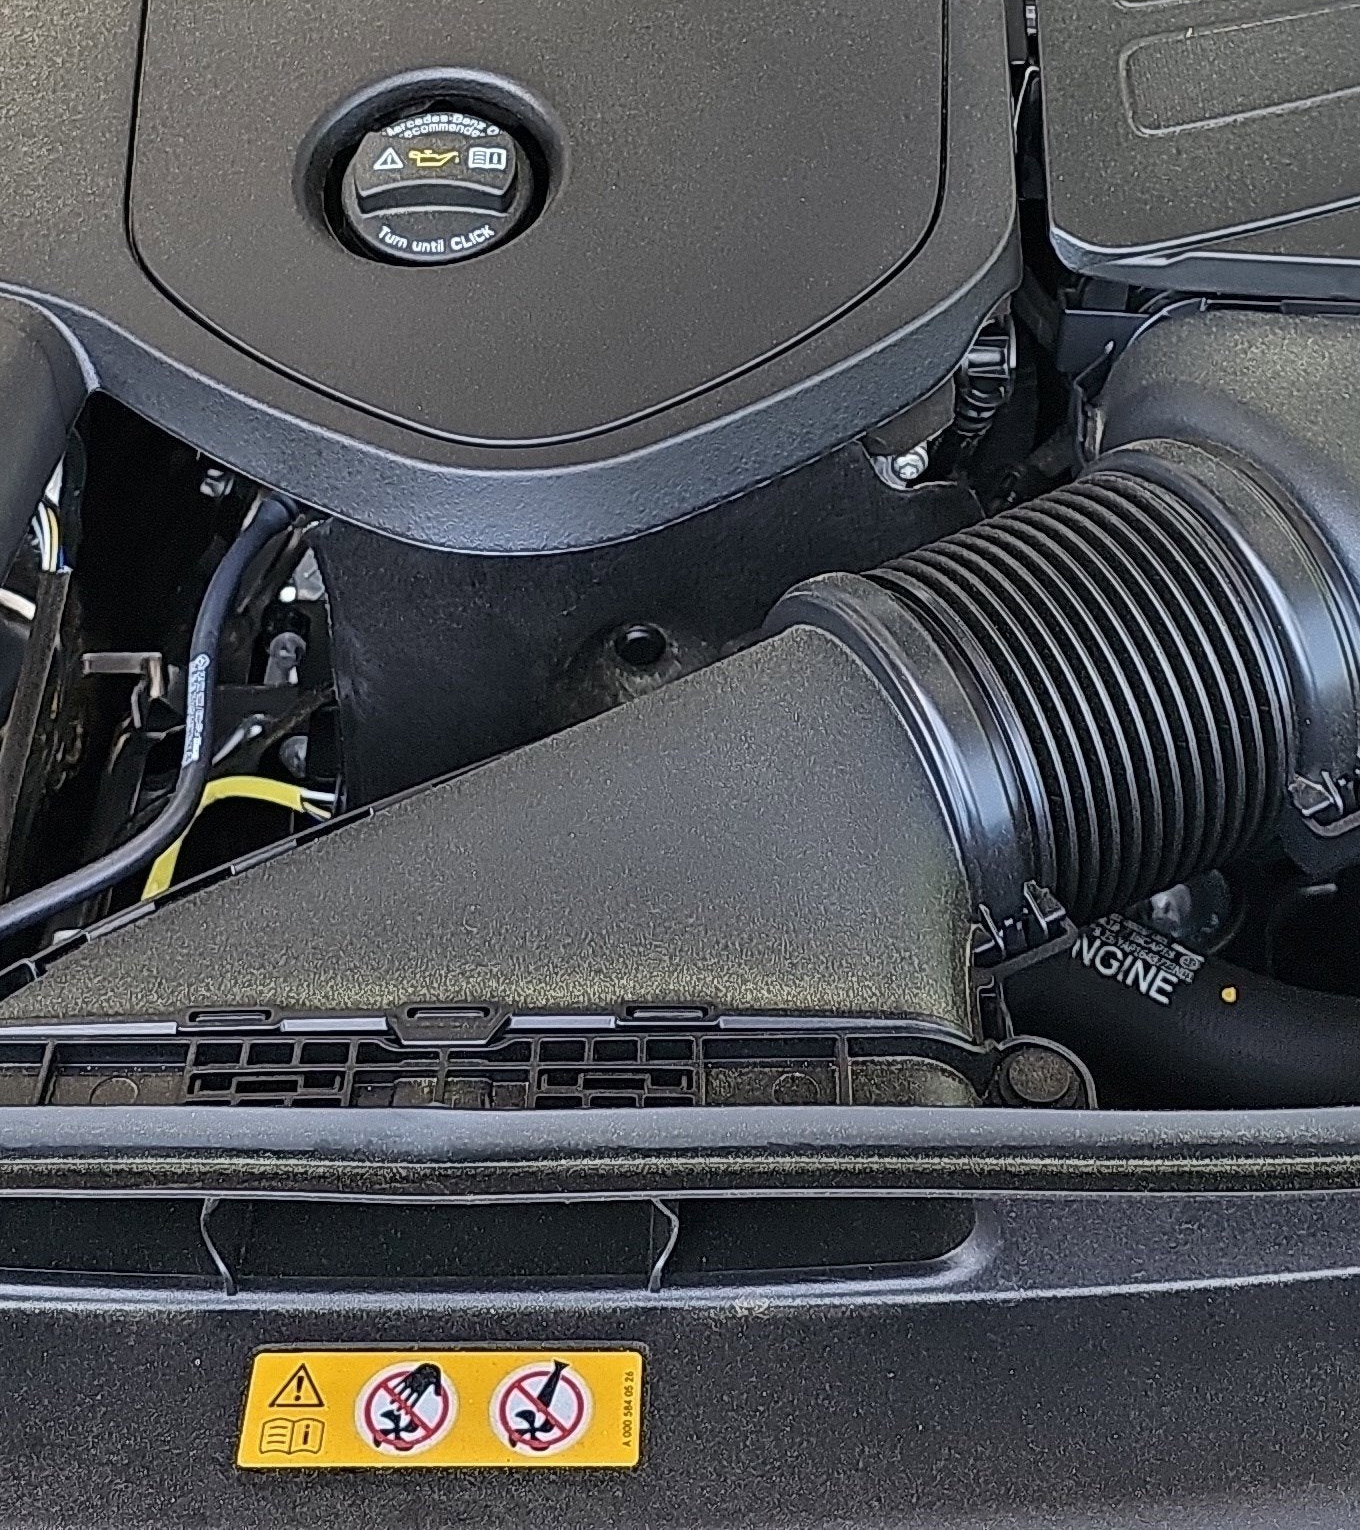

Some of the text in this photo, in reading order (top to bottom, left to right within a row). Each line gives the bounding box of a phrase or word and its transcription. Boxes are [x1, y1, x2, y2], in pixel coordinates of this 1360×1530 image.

[398, 123, 486, 139] ecommende
[378, 224, 496, 253] Turn until CLICK
[1072, 934, 1180, 1006] NGINE
[622, 1370, 634, 1448] A 000 584 05 26
